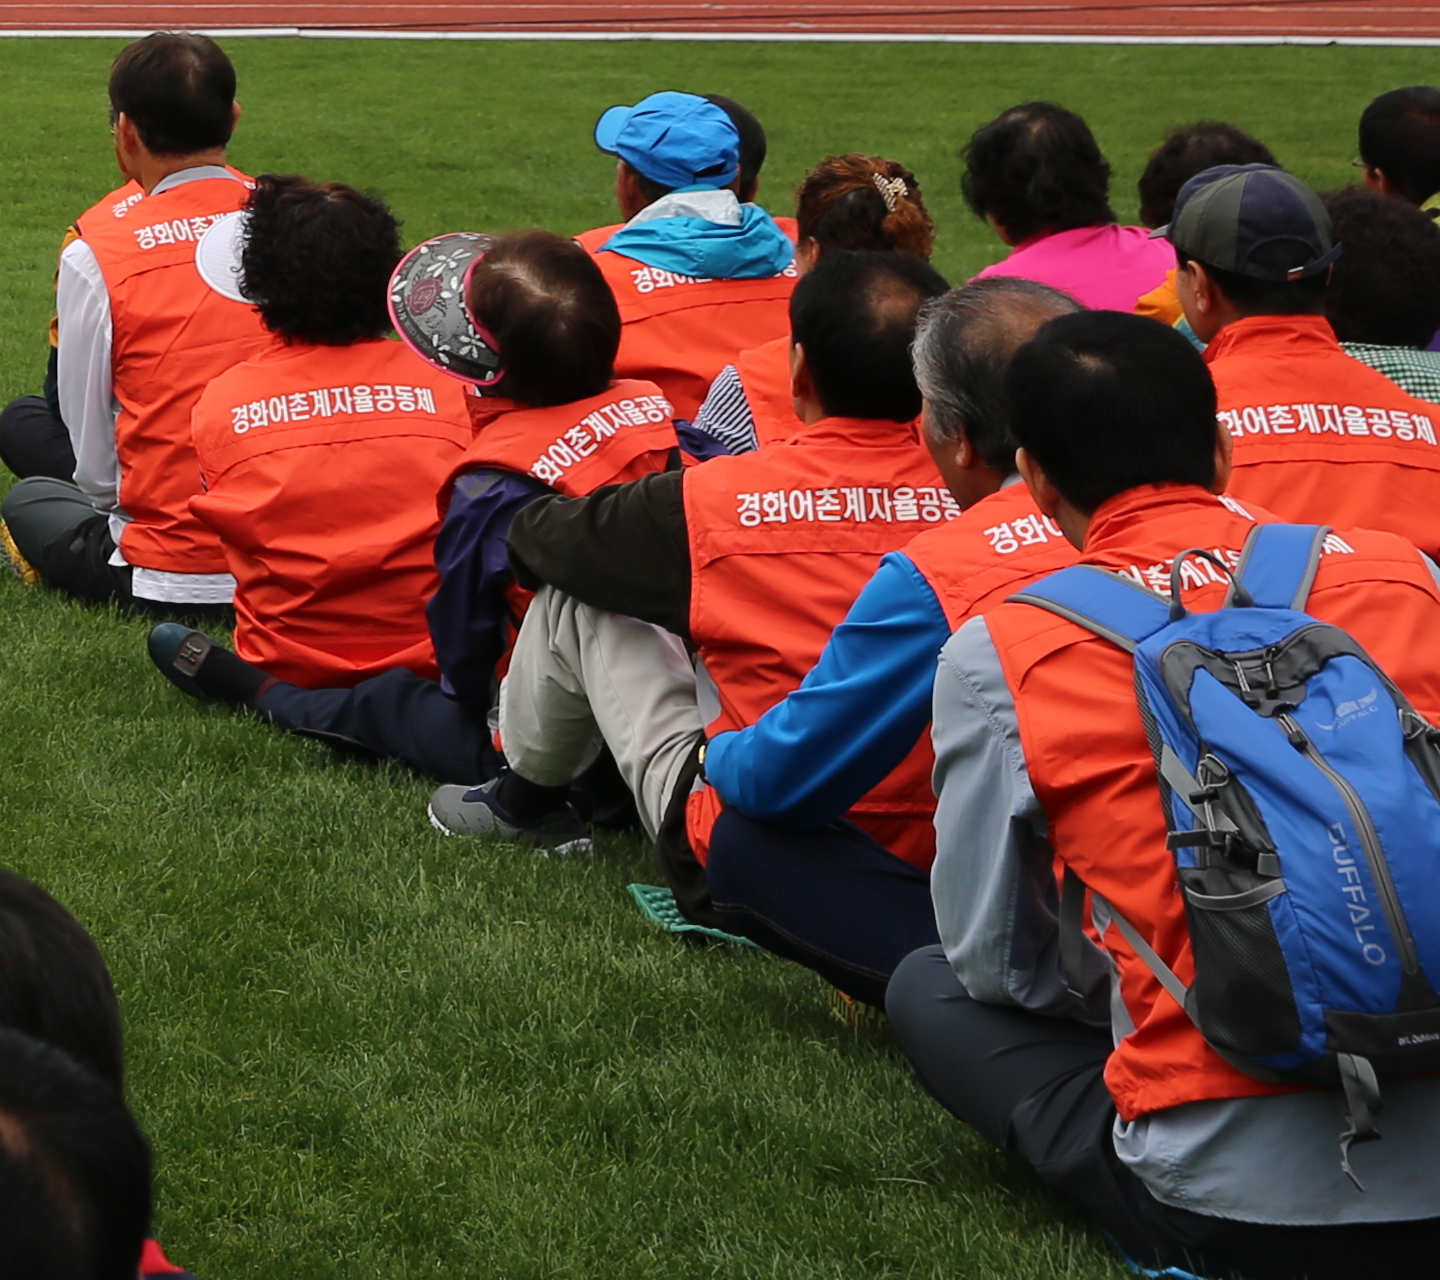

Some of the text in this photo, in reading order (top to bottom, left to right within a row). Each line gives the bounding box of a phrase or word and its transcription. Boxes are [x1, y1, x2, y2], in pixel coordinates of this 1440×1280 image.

[230, 383, 438, 434] 경화어촌계자율공동체
[1217, 402, 1438, 446] 화어촌계자율공동체
[528, 395, 675, 486] 화어촌계자율공동
